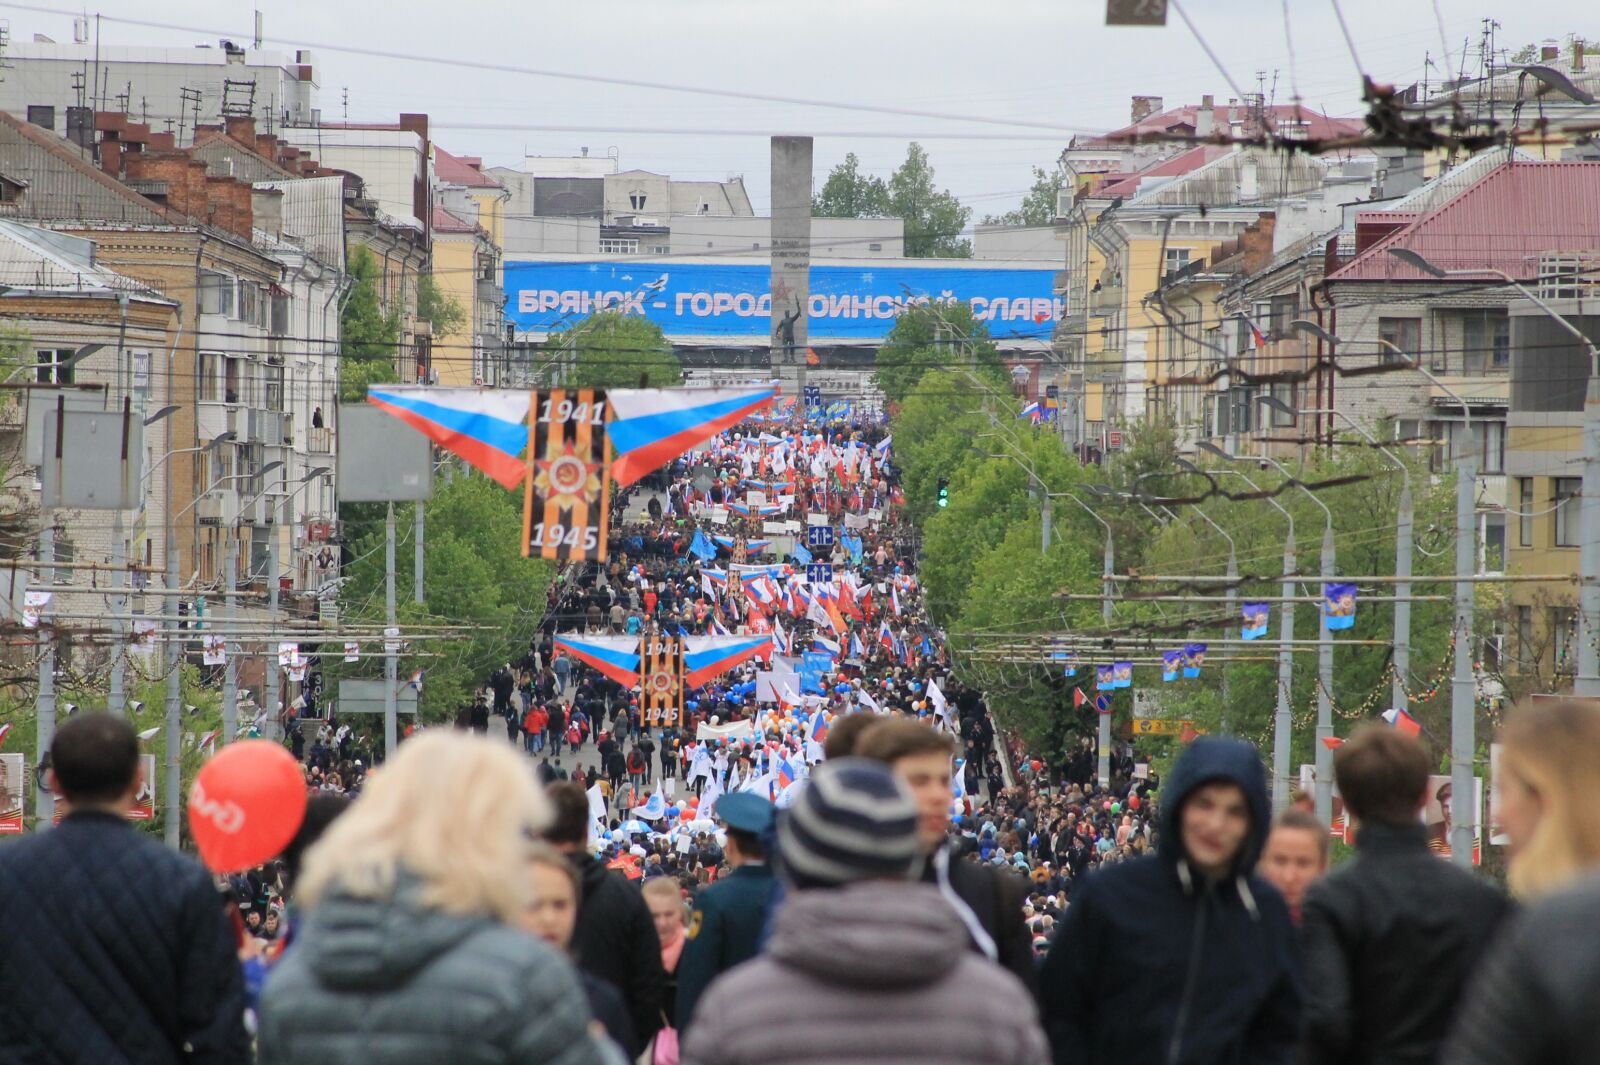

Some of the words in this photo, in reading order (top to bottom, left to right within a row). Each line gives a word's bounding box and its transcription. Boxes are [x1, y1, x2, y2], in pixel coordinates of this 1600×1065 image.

[518, 290, 646, 314] БРЯНСК
[538, 399, 606, 425] 1941
[530, 522, 599, 550] 1945
[646, 643, 679, 656] 1941
[645, 708, 679, 721] 1945
